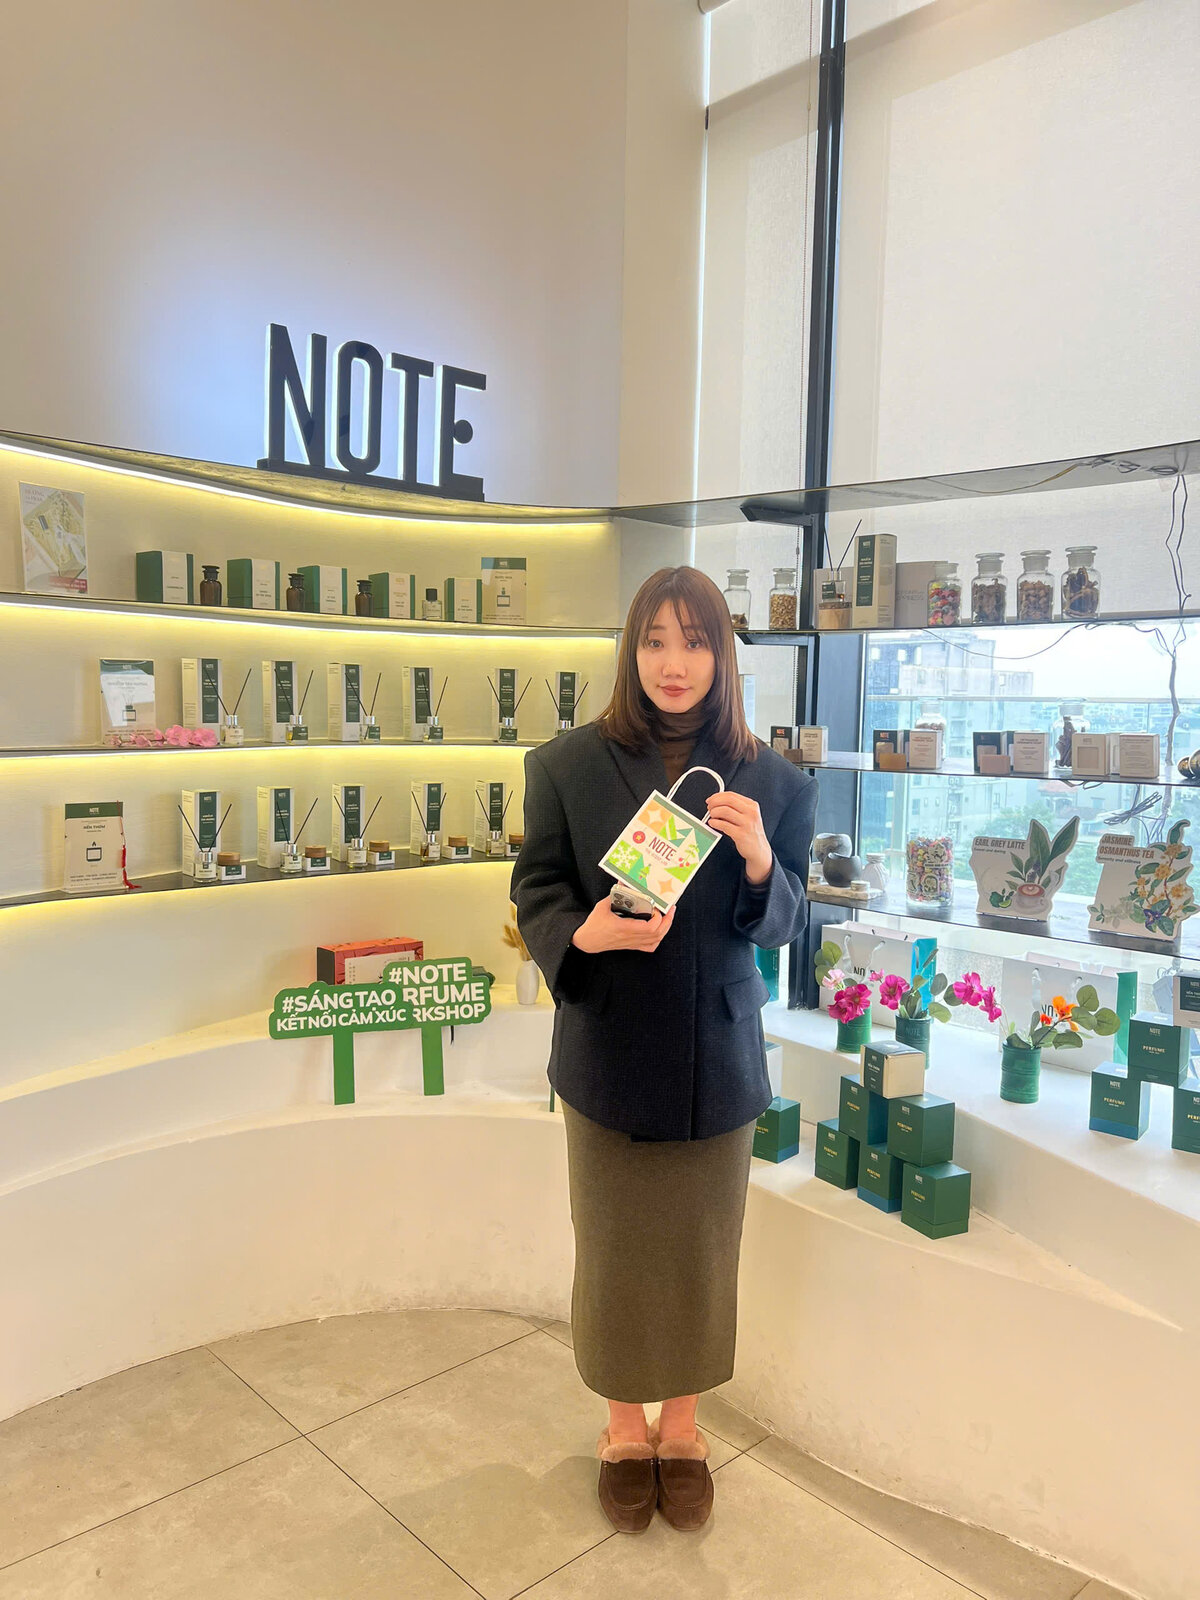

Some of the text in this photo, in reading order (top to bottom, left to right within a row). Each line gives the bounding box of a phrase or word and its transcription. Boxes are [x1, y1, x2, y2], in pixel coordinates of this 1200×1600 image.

[265, 323, 487, 501] NOTE
[975, 839, 1026, 850] EARL GREY LATTE
[1101, 836, 1132, 846] JASMINE
[649, 836, 677, 861] NOTE
[1100, 846, 1155, 859] OSMANTHUS TEA
[388, 962, 467, 986] #NOTE
[282, 989, 396, 1014] #SÁNG TẠO
[402, 982, 485, 1008] RFUME
[276, 1004, 407, 1032] KẾT NỐI CẢM XÚC
[411, 1003, 486, 1023] RKSHOP
[1103, 1097, 1125, 1105] PERFUME
[897, 1121, 913, 1131] PERFUME
[823, 1146, 838, 1155] PERFUME
[866, 1168, 881, 1177] PERFUME
[910, 1190, 926, 1201] PERFUME
